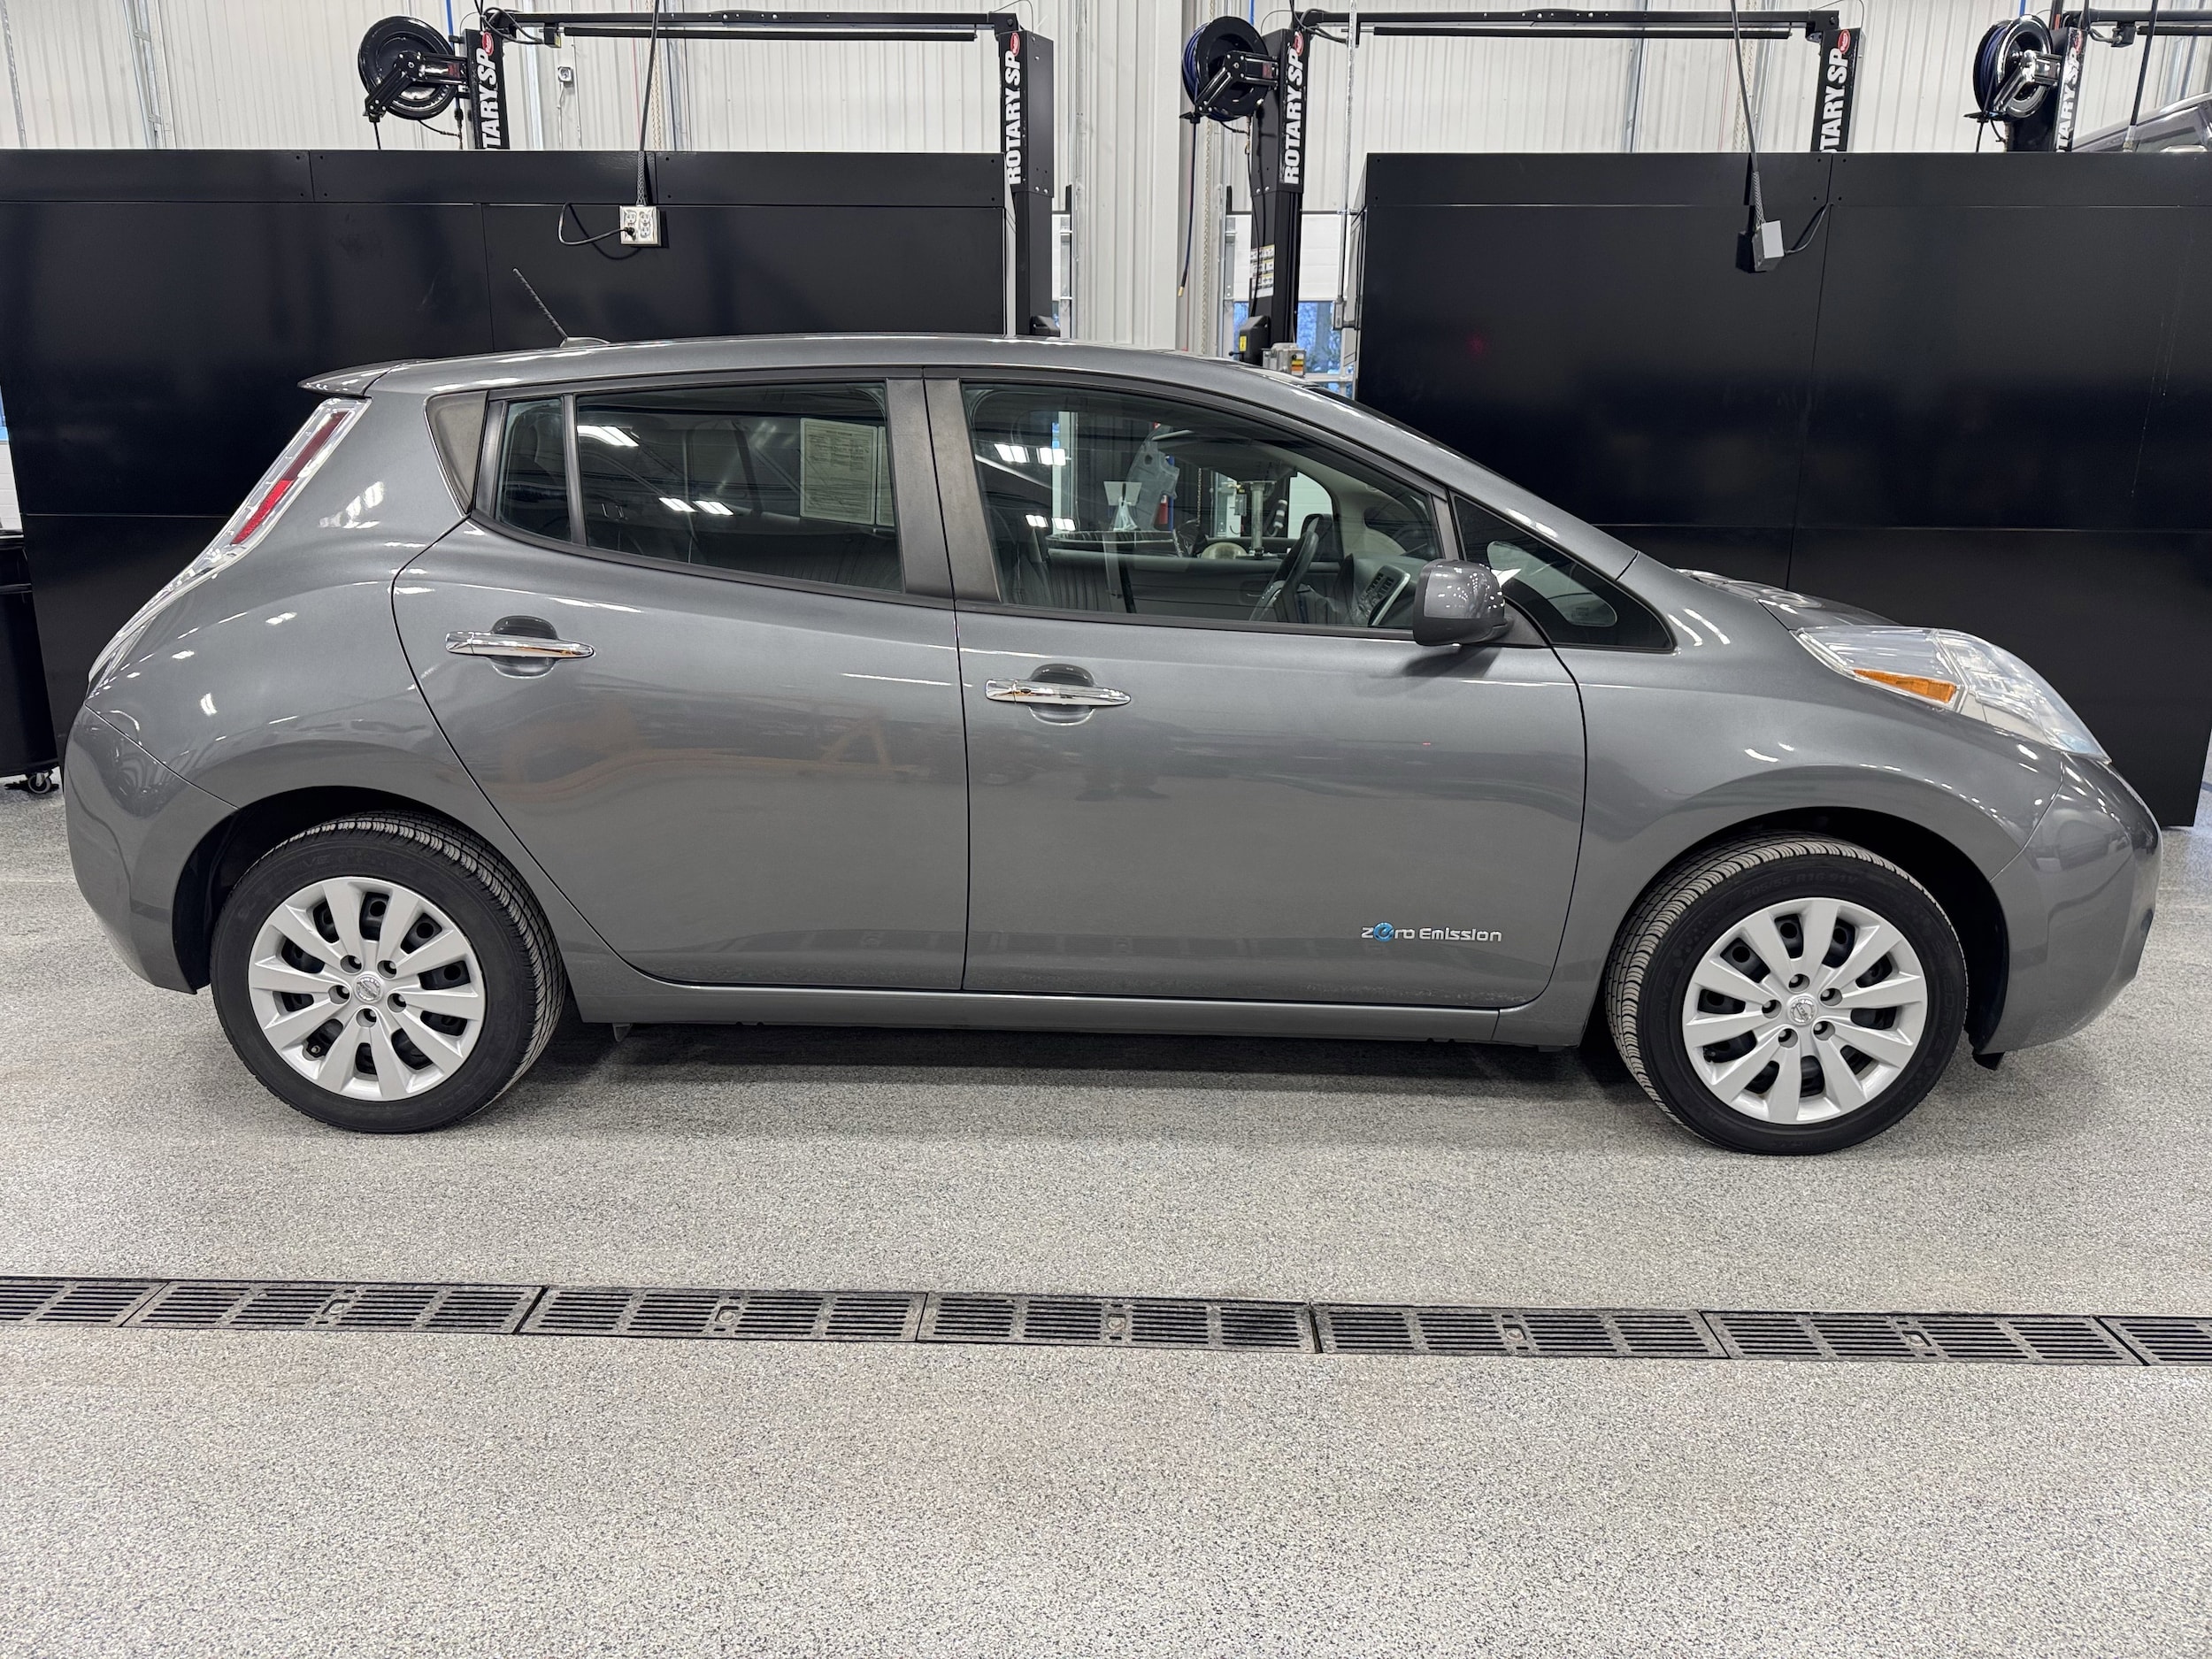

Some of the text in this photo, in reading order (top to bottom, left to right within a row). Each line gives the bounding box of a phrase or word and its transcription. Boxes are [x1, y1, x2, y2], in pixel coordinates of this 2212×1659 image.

[1005, 50, 1021, 87] SP
[1288, 48, 1304, 87] SP
[479, 84, 502, 150] TARY
[1005, 88, 1022, 185] ROTARY
[1284, 85, 1303, 185] ROTARY
[1819, 85, 1846, 151] TARY
[2056, 83, 2076, 152] TARY
[1419, 927, 1502, 941] Emission
